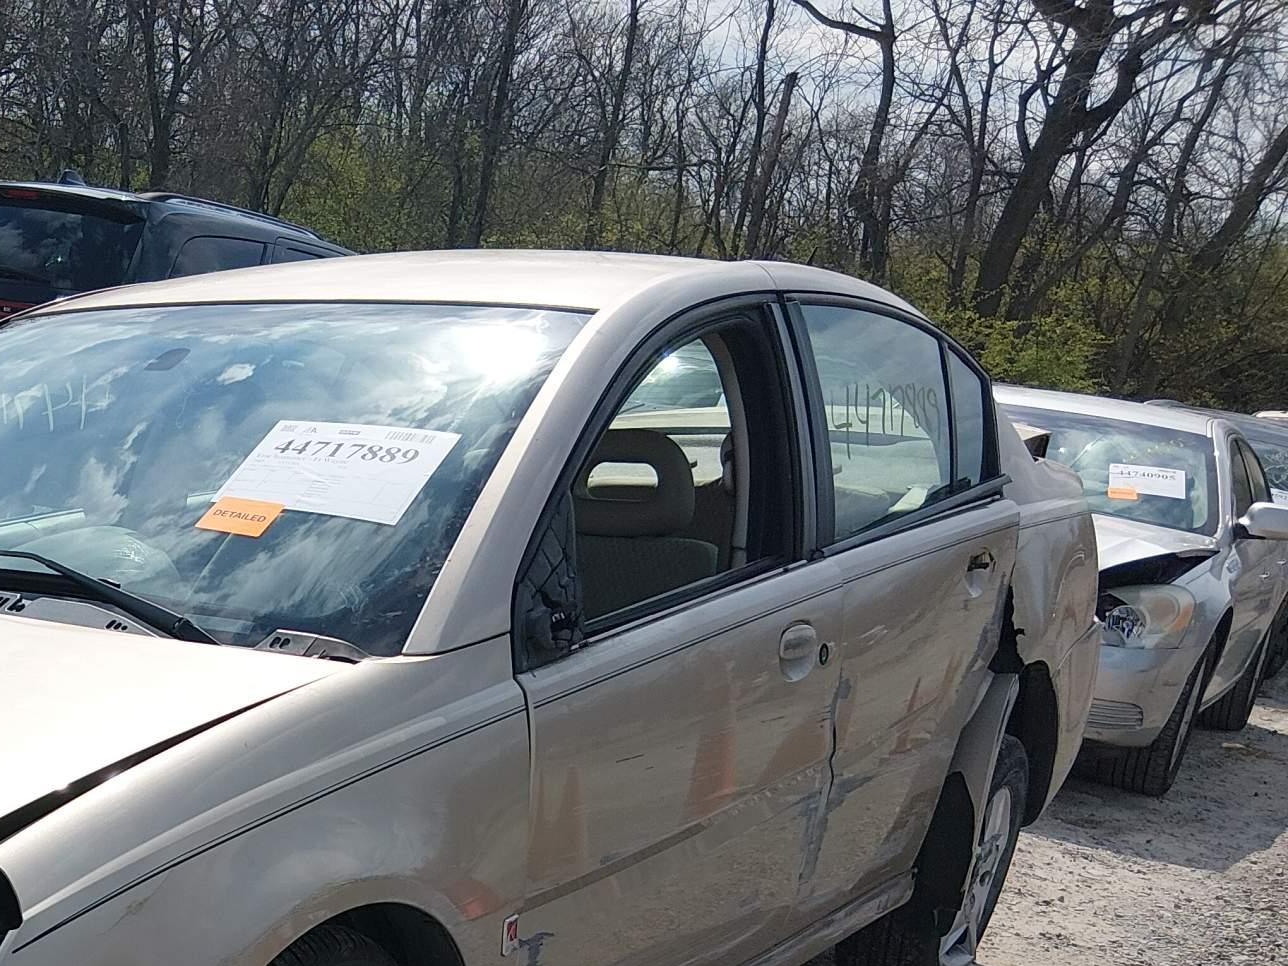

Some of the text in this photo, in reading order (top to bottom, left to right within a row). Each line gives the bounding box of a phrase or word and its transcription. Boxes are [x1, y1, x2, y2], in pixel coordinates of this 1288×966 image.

[274, 438, 420, 465] 44717889
[1120, 470, 1176, 481] 44740905
[212, 509, 267, 523] DETAILED
